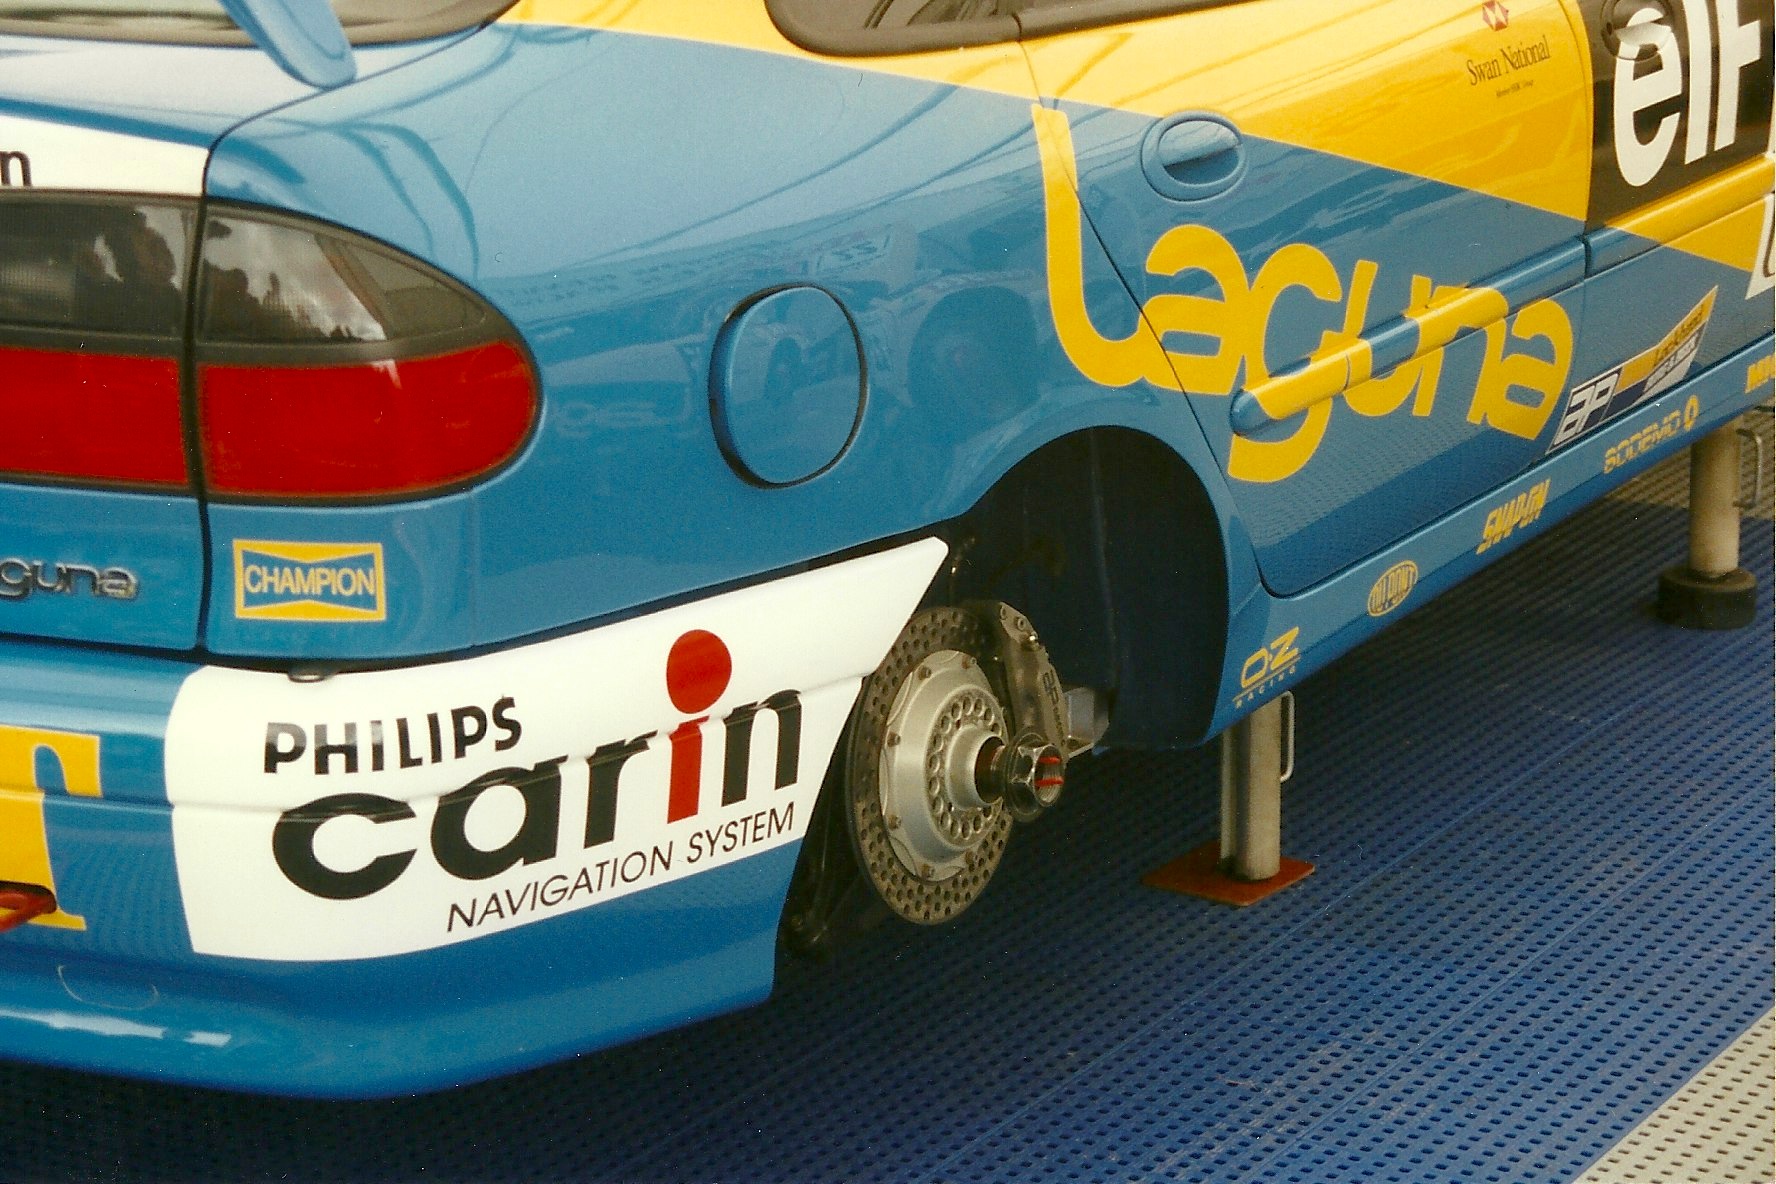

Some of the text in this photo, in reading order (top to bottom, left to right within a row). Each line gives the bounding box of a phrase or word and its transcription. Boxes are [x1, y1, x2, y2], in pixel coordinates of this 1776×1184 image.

[1467, 35, 1551, 86] Swan National
[1614, 0, 1761, 187] elf
[243, 565, 375, 597] CHAMPION
[264, 696, 523, 774] PHILIPS
[271, 629, 802, 900] carin
[447, 802, 795, 933] NAVIGATION SYSTEM
